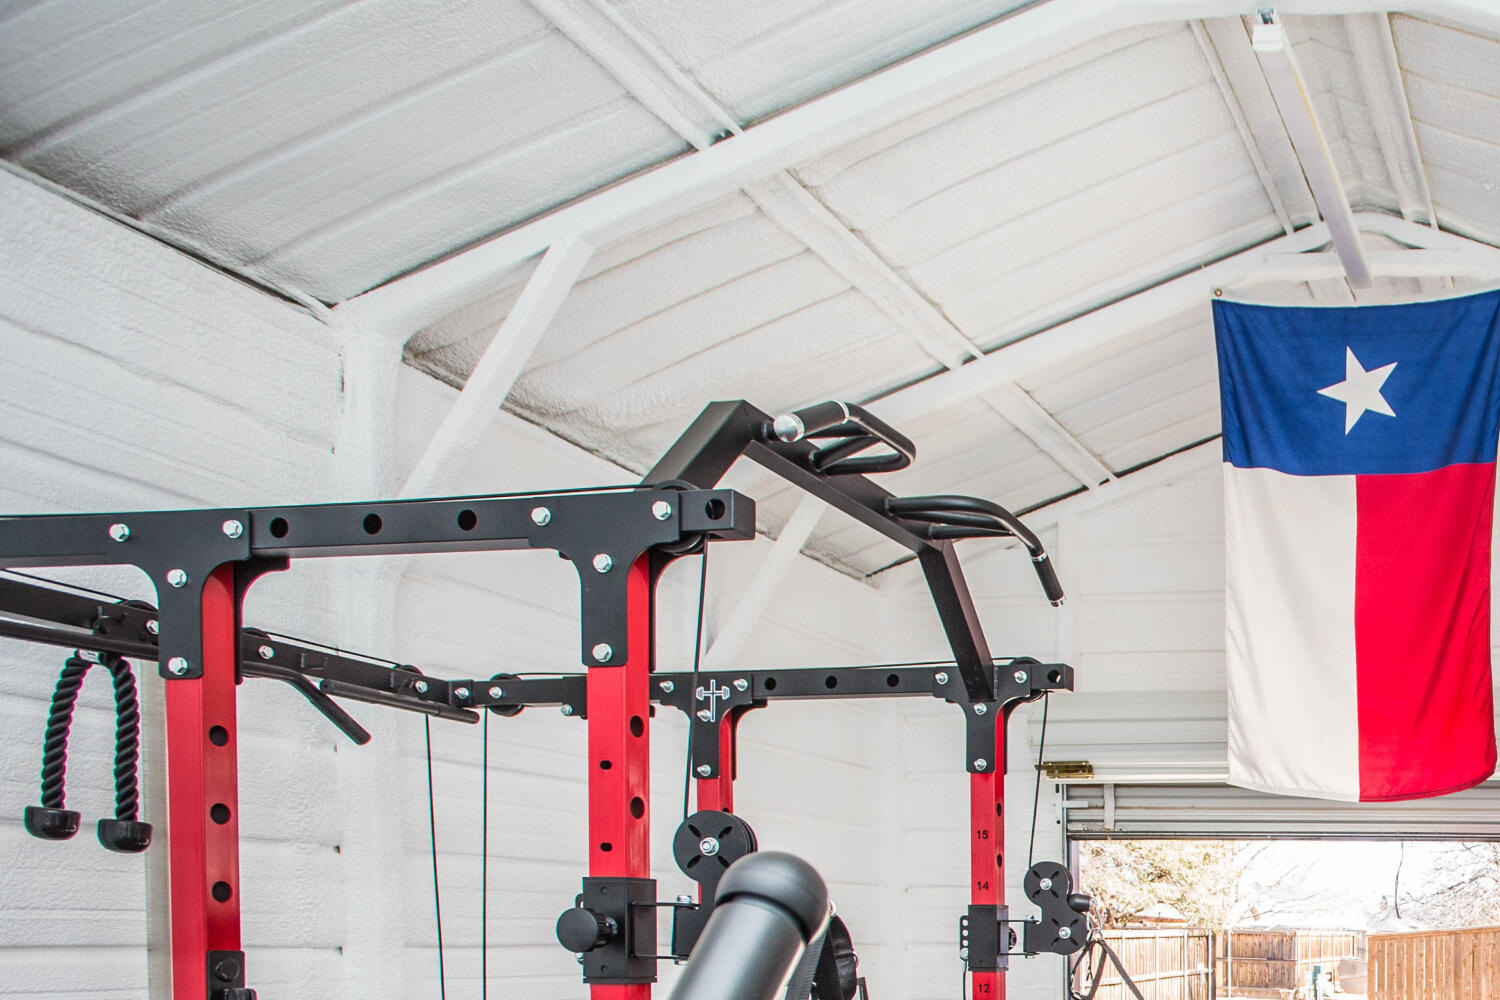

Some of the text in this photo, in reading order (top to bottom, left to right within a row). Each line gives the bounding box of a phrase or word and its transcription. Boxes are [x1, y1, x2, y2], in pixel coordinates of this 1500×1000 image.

[976, 829, 989, 840] 15
[977, 881, 989, 891] 14
[978, 983, 990, 994] 12
